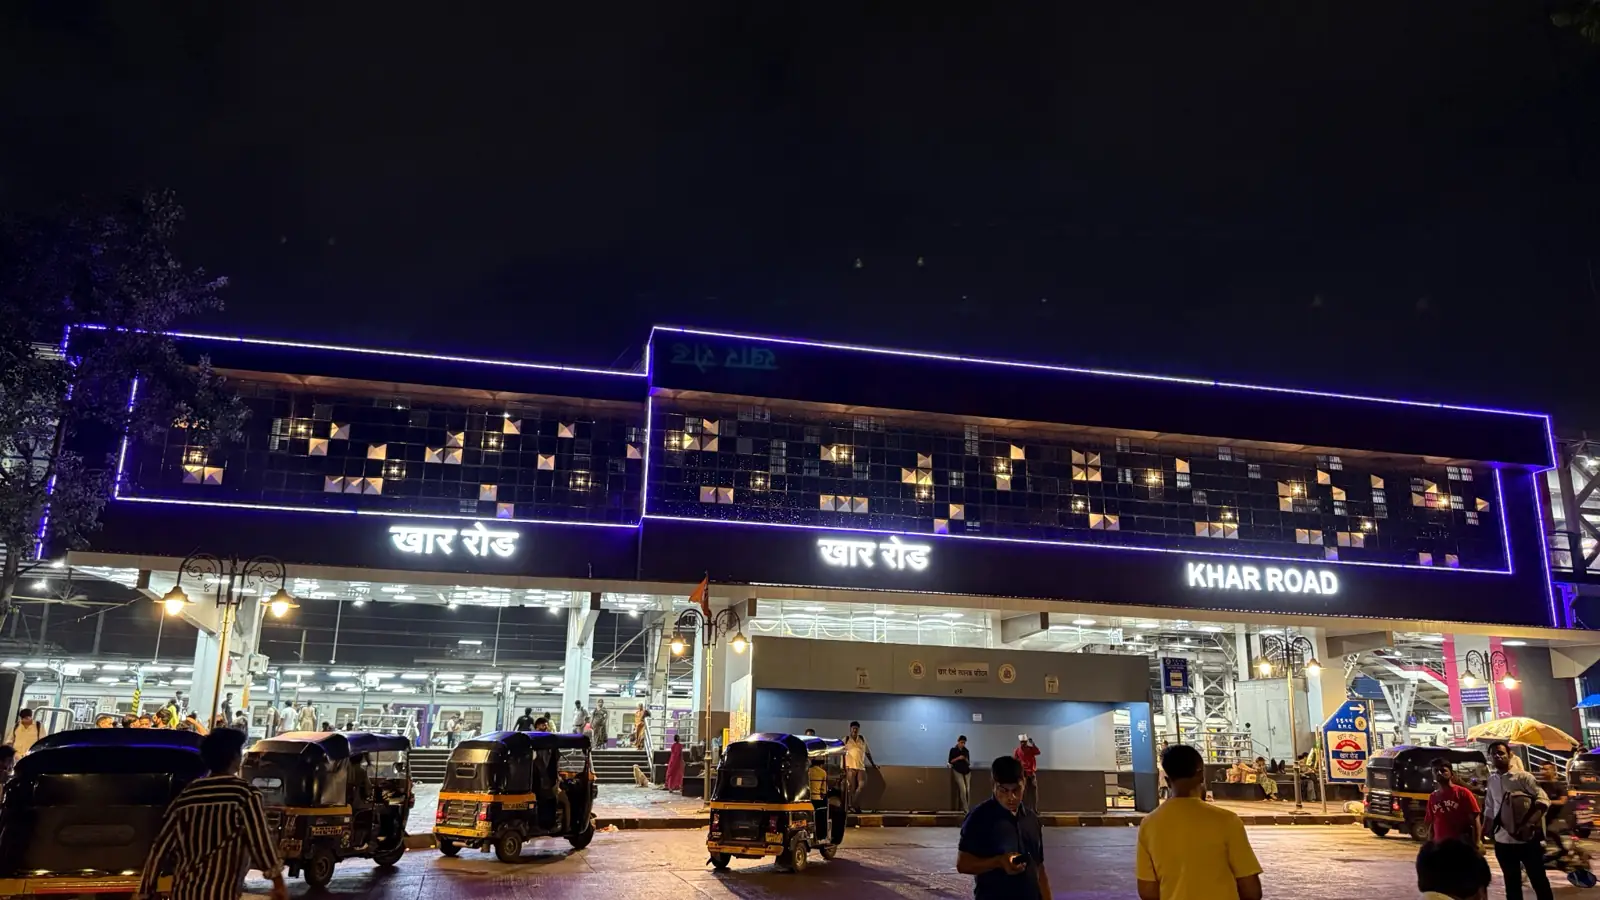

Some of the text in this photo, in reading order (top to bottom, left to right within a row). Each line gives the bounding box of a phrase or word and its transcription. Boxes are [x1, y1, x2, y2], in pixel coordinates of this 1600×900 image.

[389, 521, 520, 557] खार रोड
[817, 535, 931, 571] खार रोड
[1187, 562, 1339, 595] KHAR ROAD
